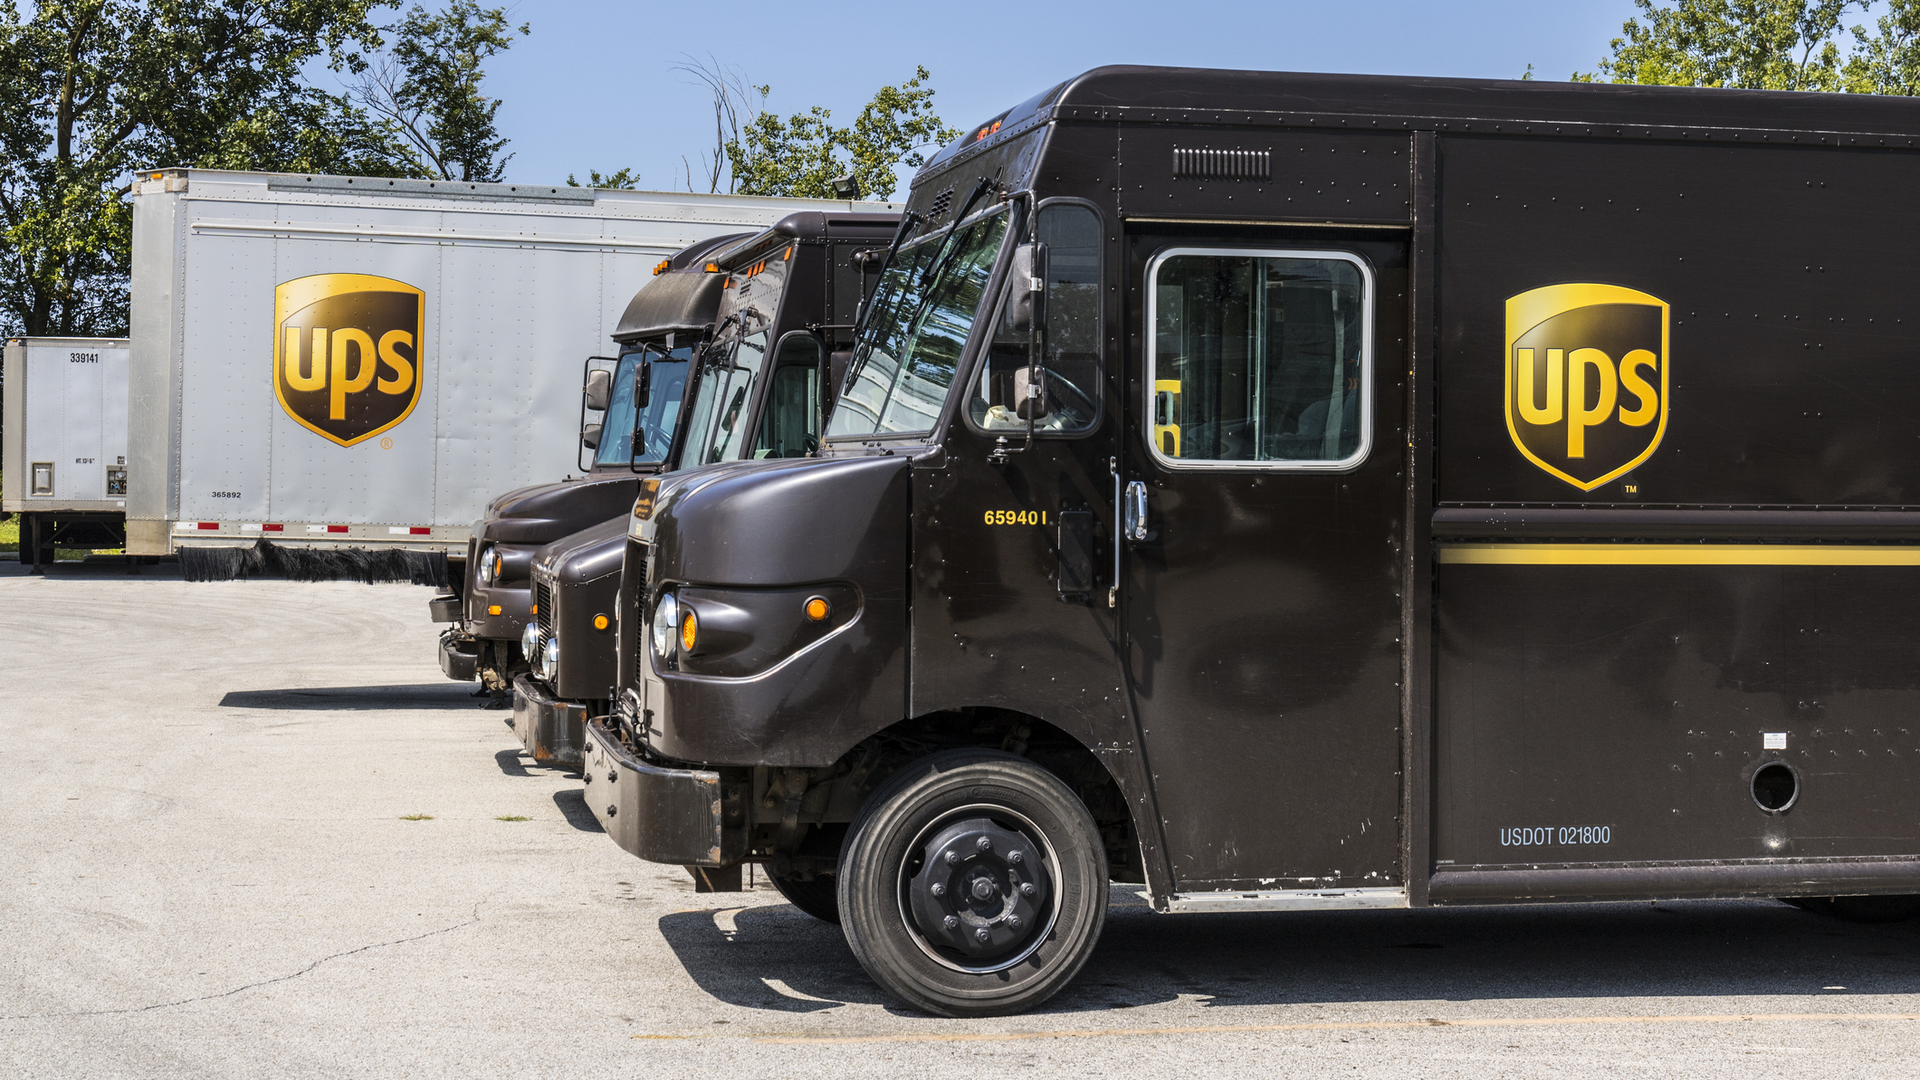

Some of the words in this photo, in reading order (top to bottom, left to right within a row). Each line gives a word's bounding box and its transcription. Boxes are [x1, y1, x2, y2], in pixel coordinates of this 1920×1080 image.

[70, 352, 98, 363] 339141
[285, 327, 414, 420] ups
[1516, 347, 1659, 459] ups
[1625, 485, 1637, 493] TM
[984, 510, 1047, 526] 659401
[1501, 827, 1554, 846] USDOT
[1559, 826, 1611, 845] 021800
